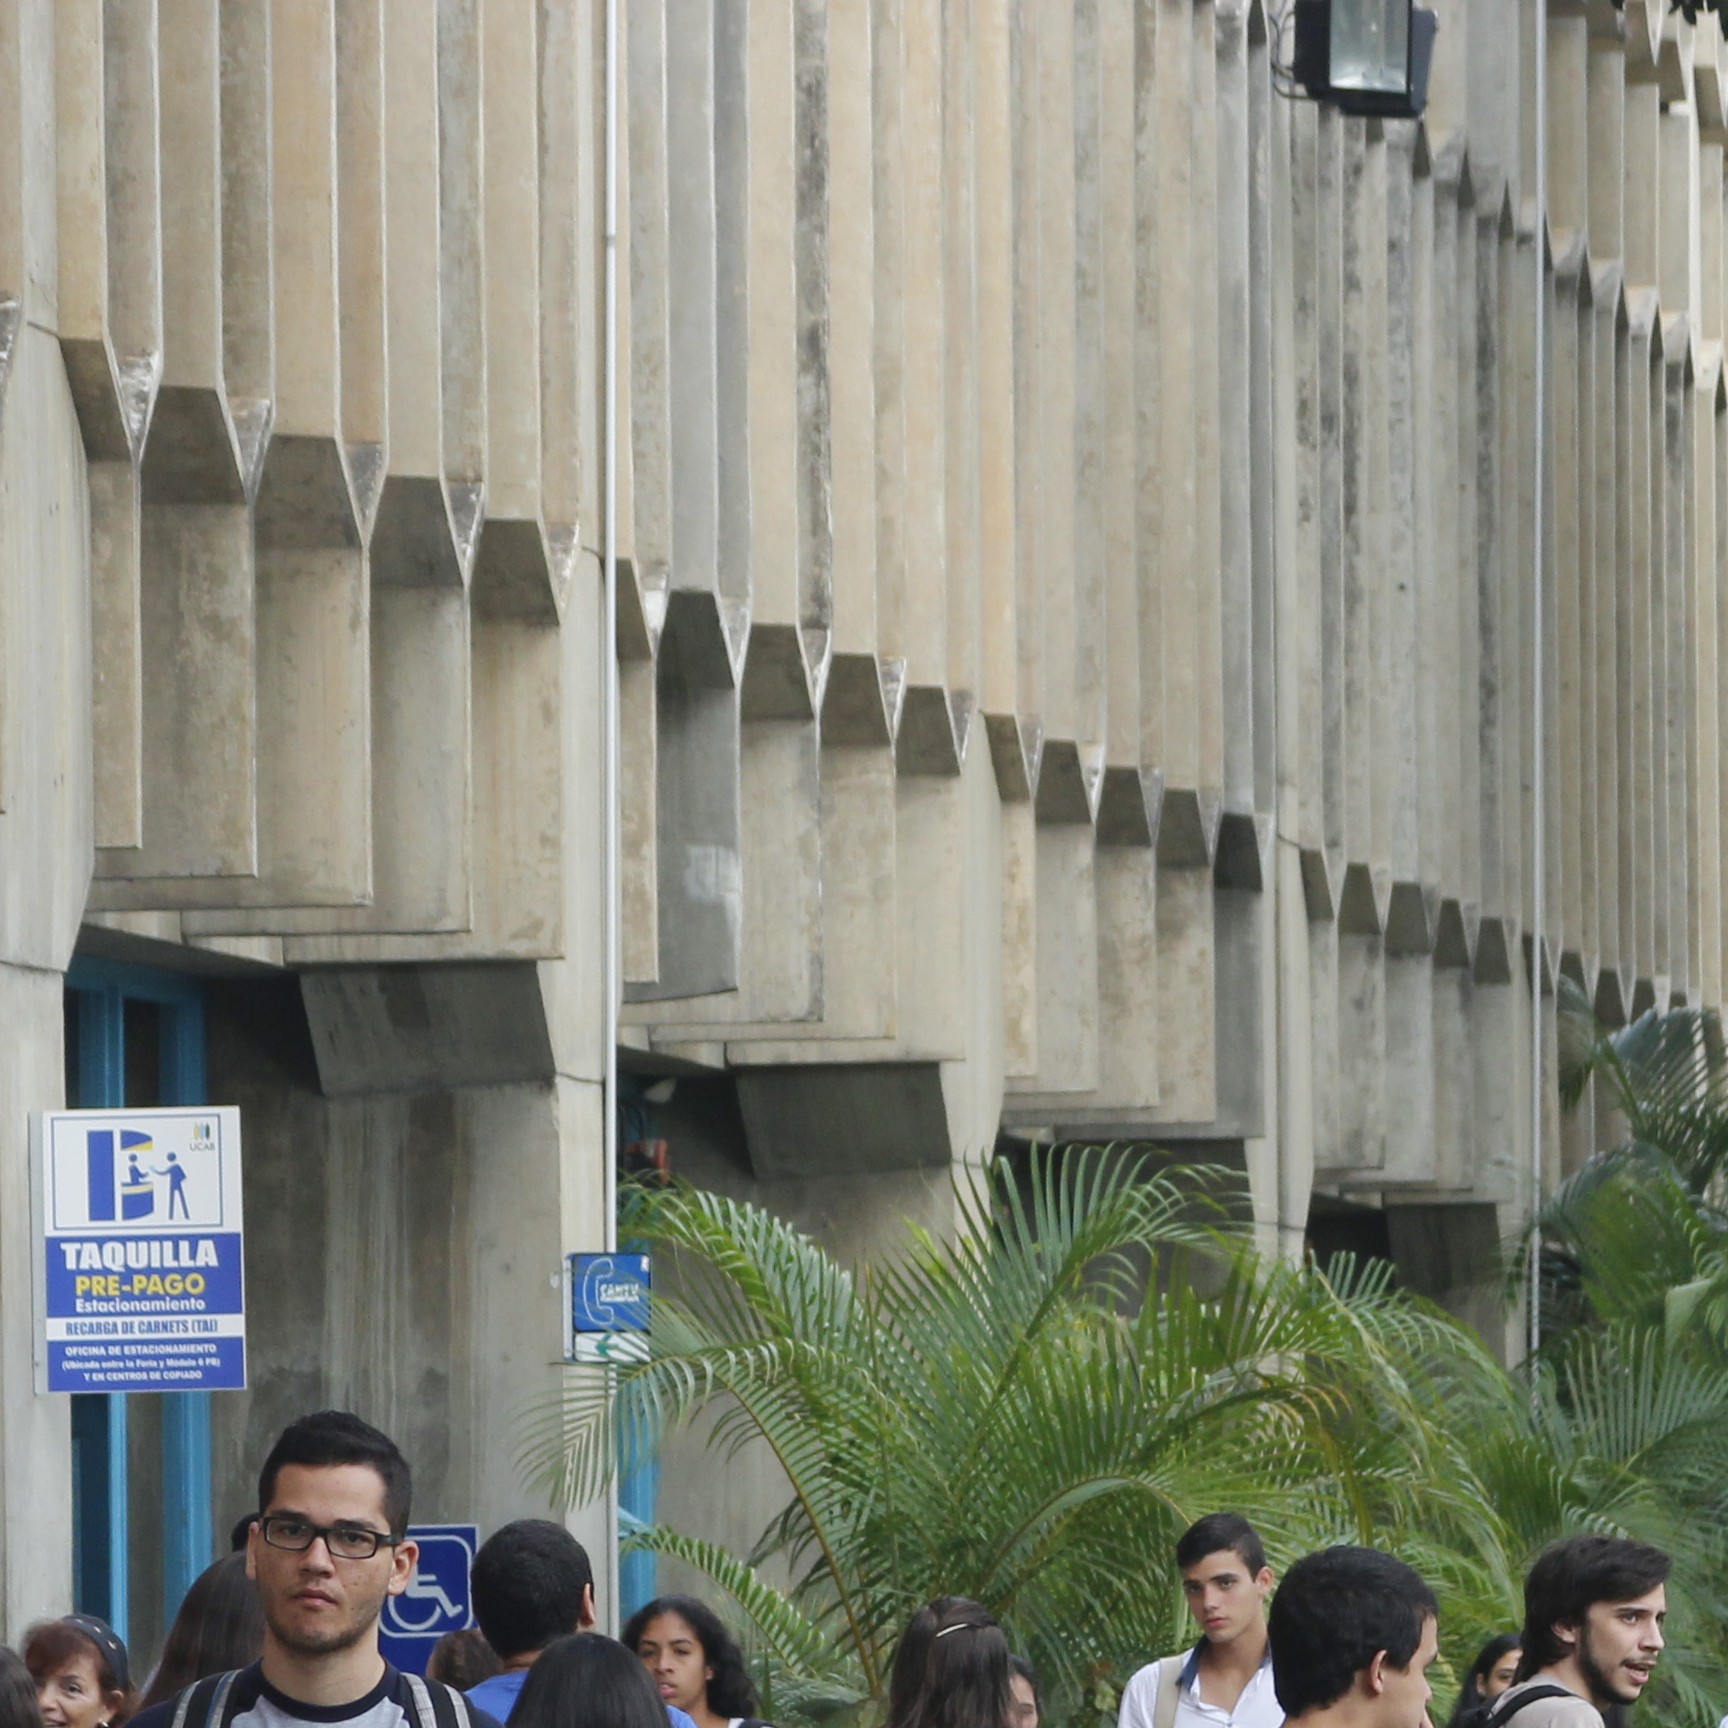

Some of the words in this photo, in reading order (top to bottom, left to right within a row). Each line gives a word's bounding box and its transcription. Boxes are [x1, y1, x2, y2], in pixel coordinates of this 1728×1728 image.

[189, 1142, 216, 1151] UCAB
[60, 1240, 219, 1272] TAQUILLA
[75, 1272, 206, 1297] PRE-PAGO
[75, 1296, 206, 1314] Estacionamiento
[66, 1321, 119, 1336] RECARGA
[121, 1321, 136, 1335] DE
[138, 1320, 189, 1334] CARNETS
[65, 1345, 107, 1357] OFICINA
[108, 1345, 122, 1356] DE
[123, 1343, 218, 1355] ESTACIONAMIENTO
[83, 1372, 91, 1382] Y
[92, 1372, 105, 1381] EN
[106, 1371, 148, 1381] CENTROS
[149, 1371, 161, 1380] DE
[163, 1370, 203, 1380] COPIADO
